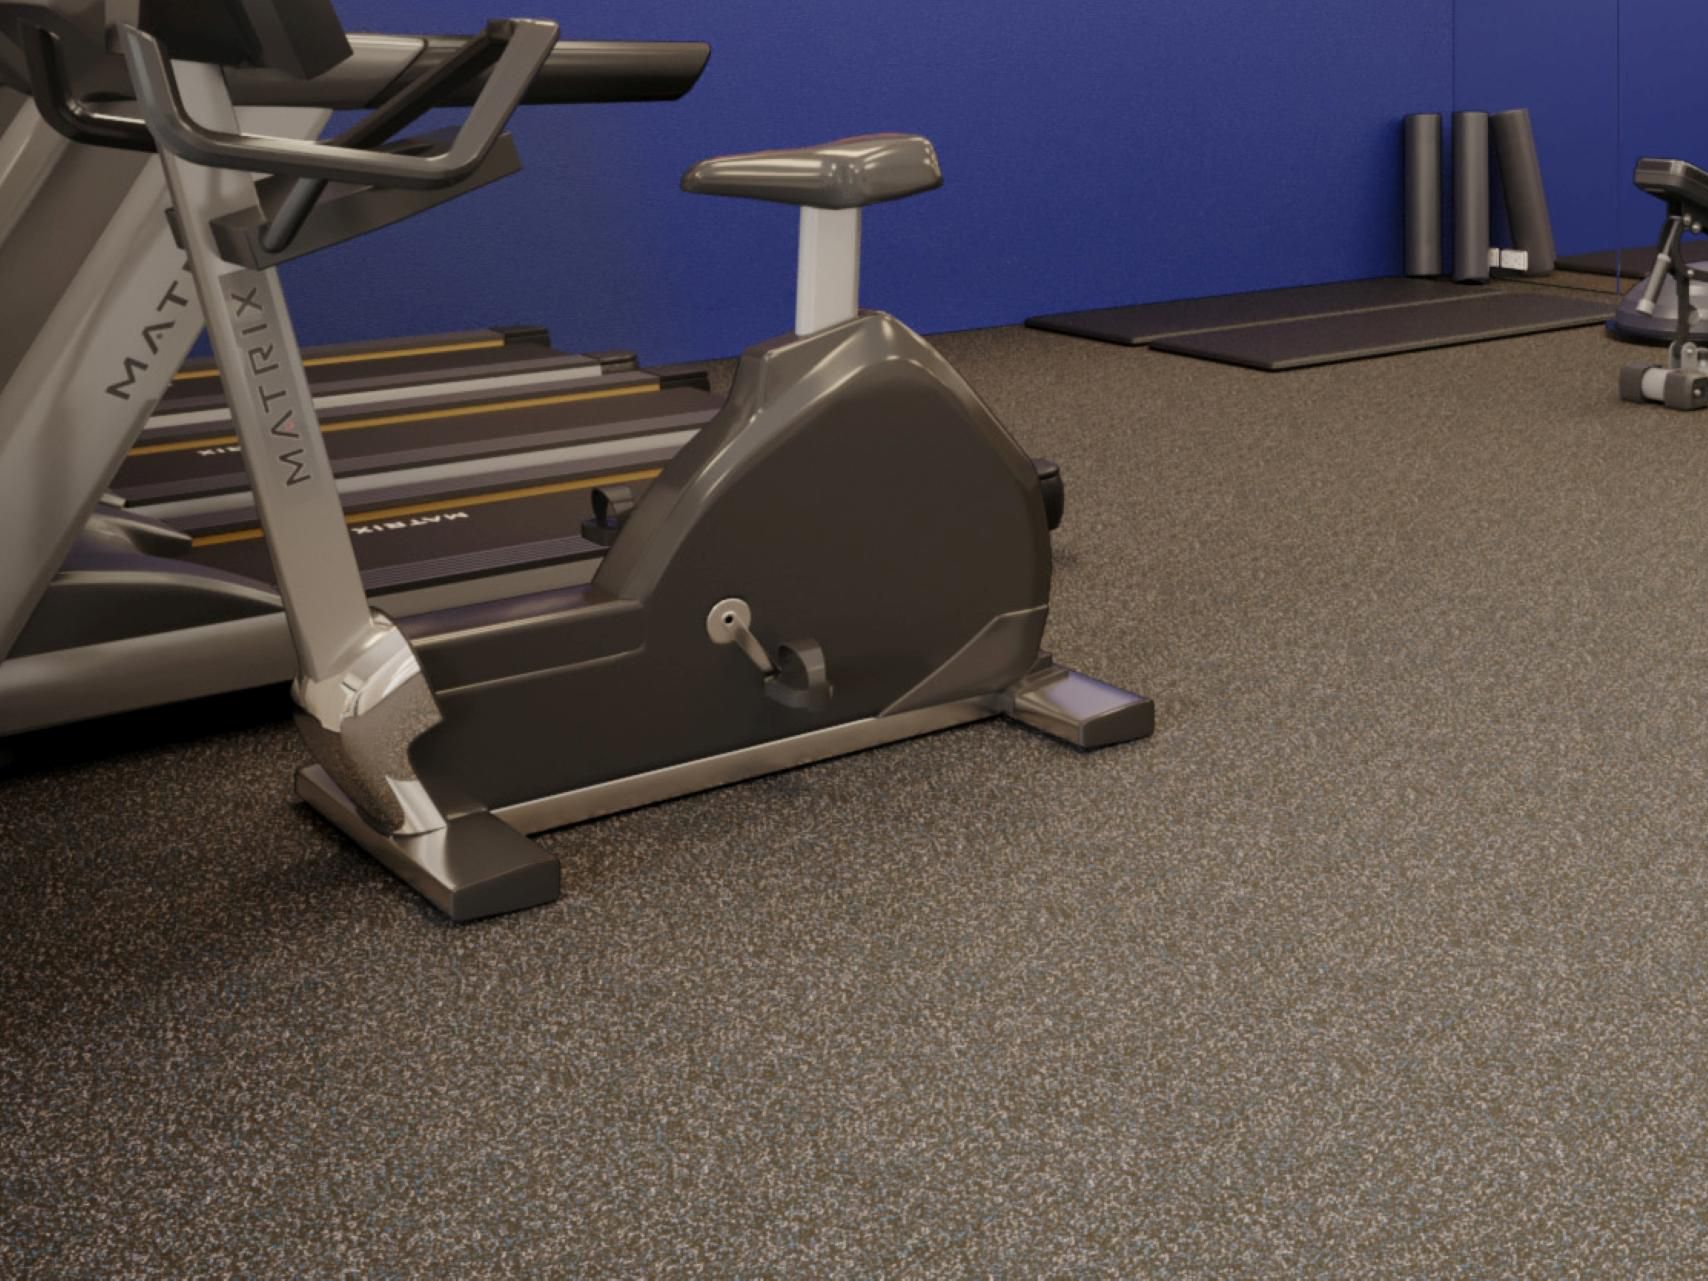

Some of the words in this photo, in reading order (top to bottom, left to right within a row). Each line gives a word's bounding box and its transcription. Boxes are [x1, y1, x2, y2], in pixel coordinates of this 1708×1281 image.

[105, 278, 190, 401] MAT
[230, 286, 312, 487] MATRIX
[351, 510, 470, 535] MATRIX
